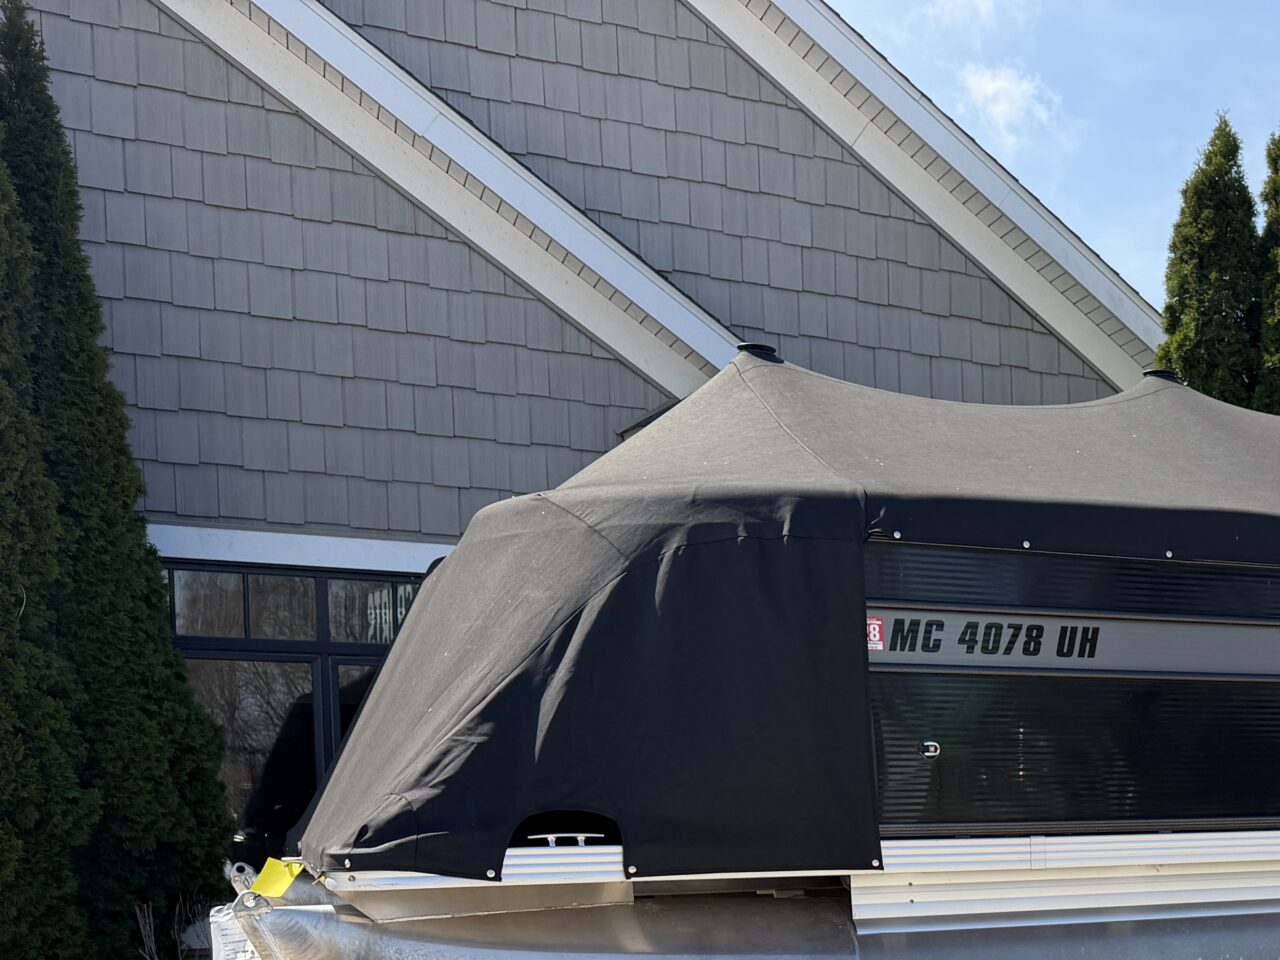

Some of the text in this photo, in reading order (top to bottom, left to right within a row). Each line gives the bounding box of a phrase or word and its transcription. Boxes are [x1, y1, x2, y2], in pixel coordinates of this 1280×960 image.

[889, 618, 1100, 658] MC 4078 UH
